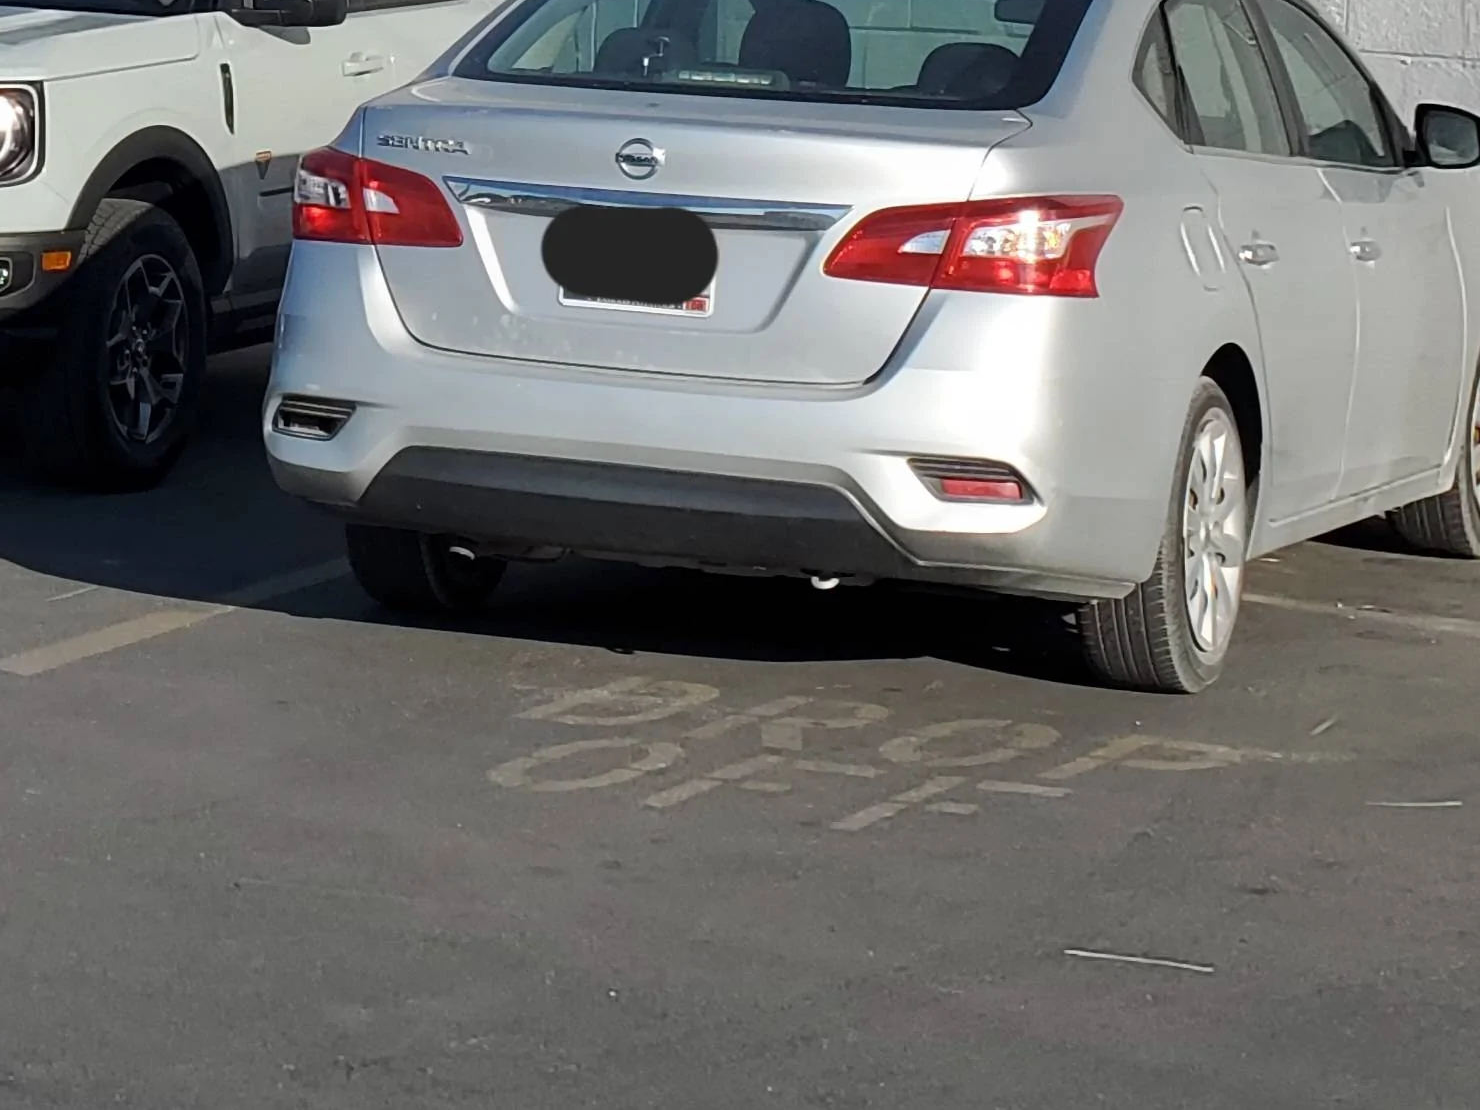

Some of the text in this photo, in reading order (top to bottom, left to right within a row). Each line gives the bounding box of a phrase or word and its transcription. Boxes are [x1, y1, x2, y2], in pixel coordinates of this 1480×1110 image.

[377, 134, 471, 155] SENTRA
[516, 674, 1275, 780] DROP
[486, 736, 1073, 832] OFF
